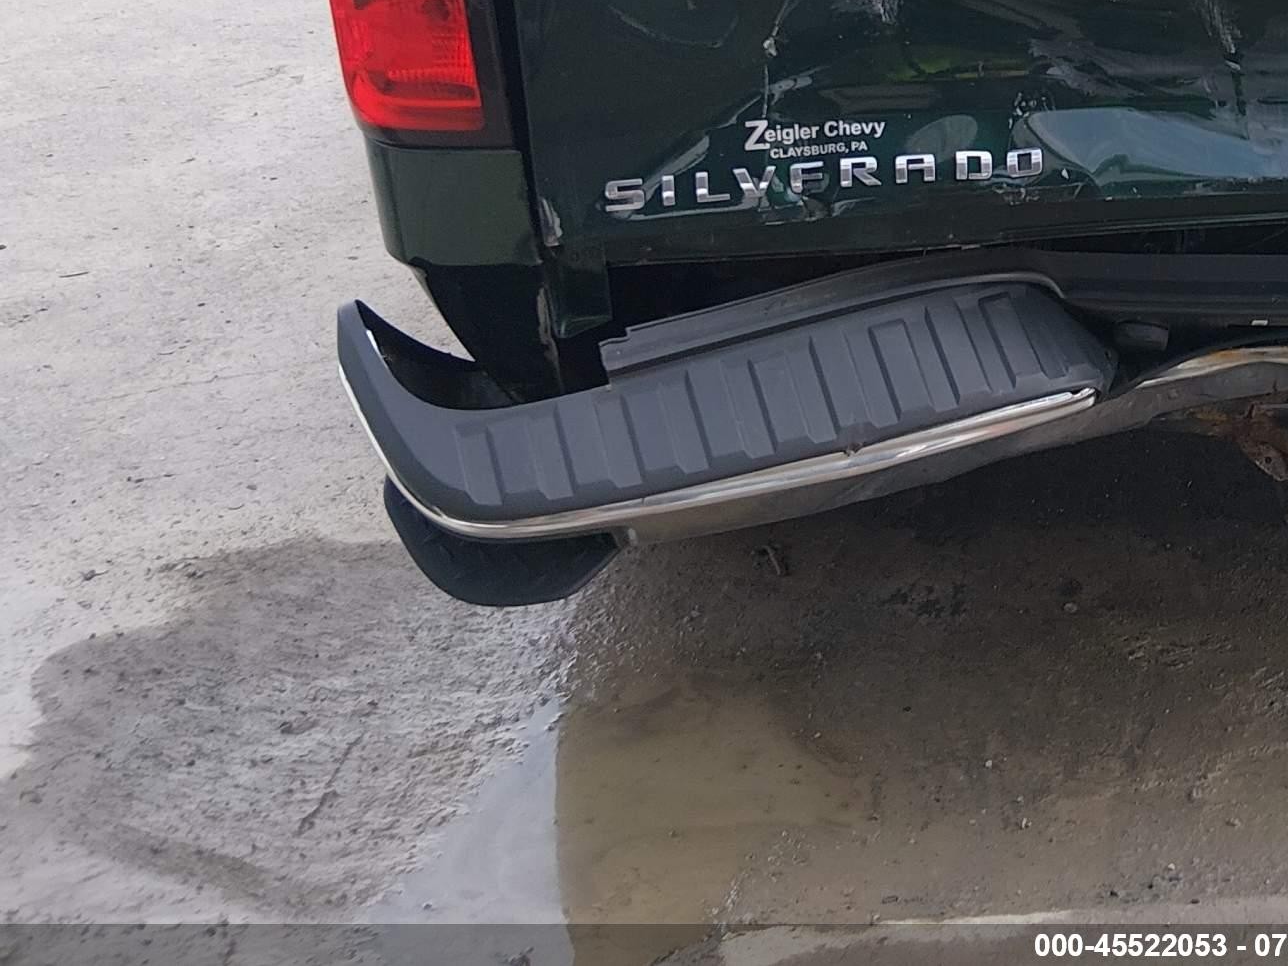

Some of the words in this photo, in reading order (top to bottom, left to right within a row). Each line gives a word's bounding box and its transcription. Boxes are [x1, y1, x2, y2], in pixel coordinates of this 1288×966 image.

[744, 119, 820, 151] Zeigler
[824, 120, 886, 138] Chevy
[770, 142, 849, 159] CLAYSBURG,
[851, 140, 868, 152] PA
[603, 147, 1044, 213] SILVERADO
